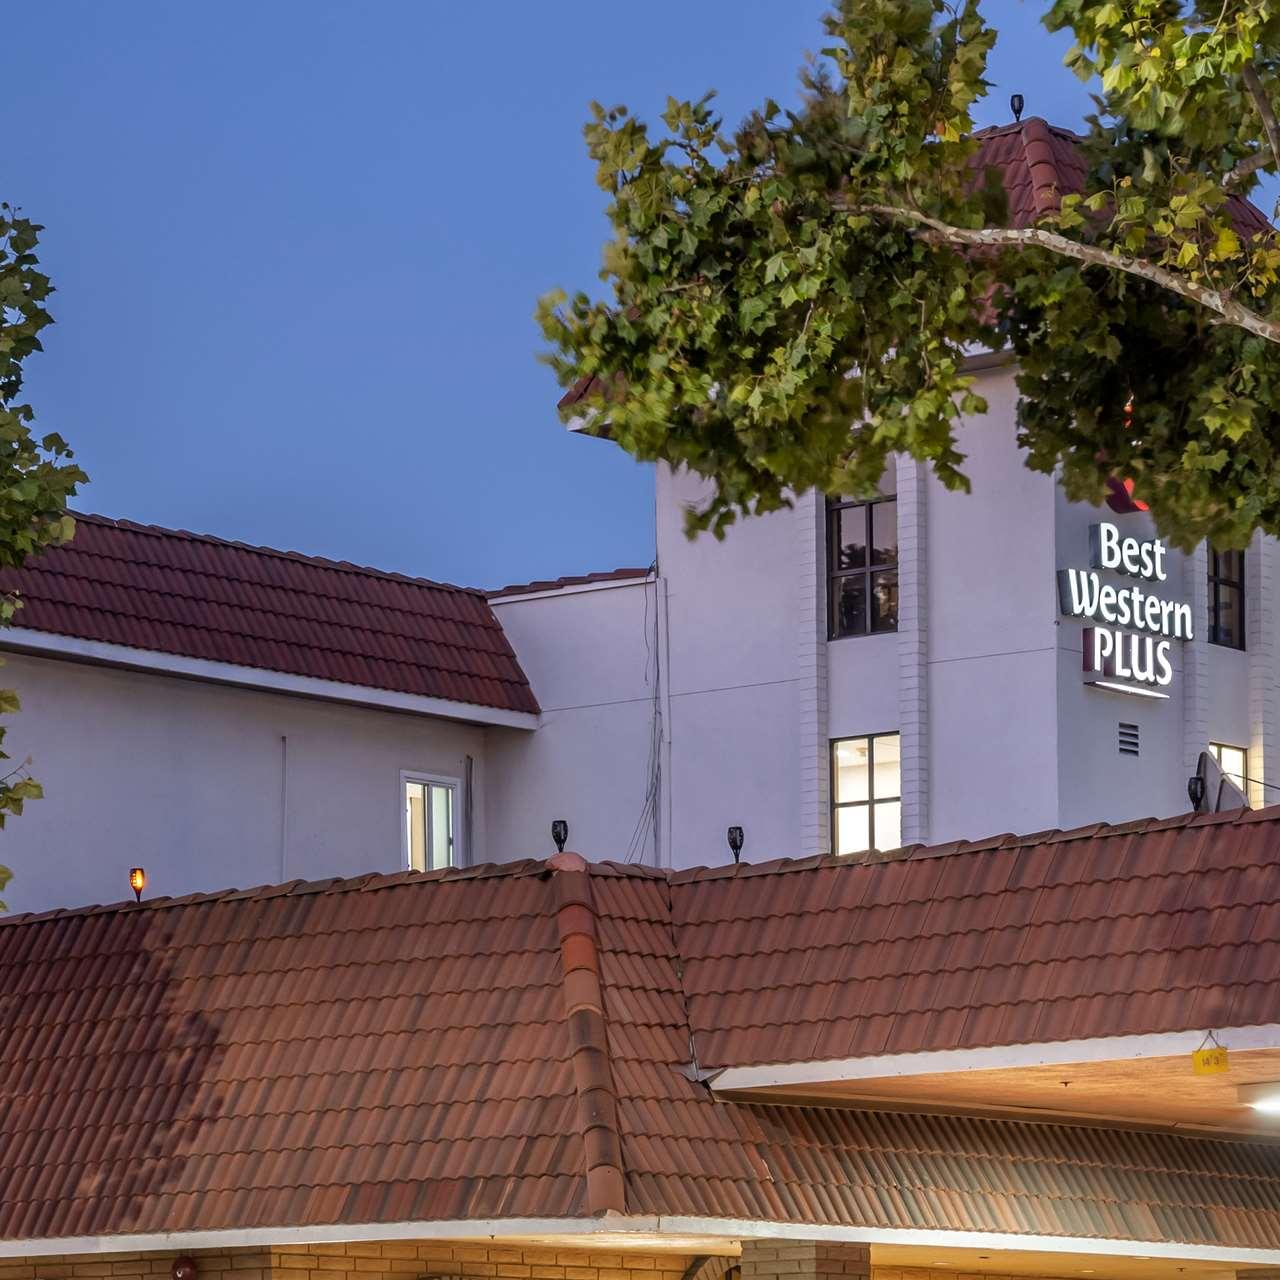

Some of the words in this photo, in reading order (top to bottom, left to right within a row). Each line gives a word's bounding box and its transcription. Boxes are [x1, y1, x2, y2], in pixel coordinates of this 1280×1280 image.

[1099, 522, 1167, 581] Best
[1068, 568, 1193, 639] Western
[1093, 627, 1172, 685] PLUS
